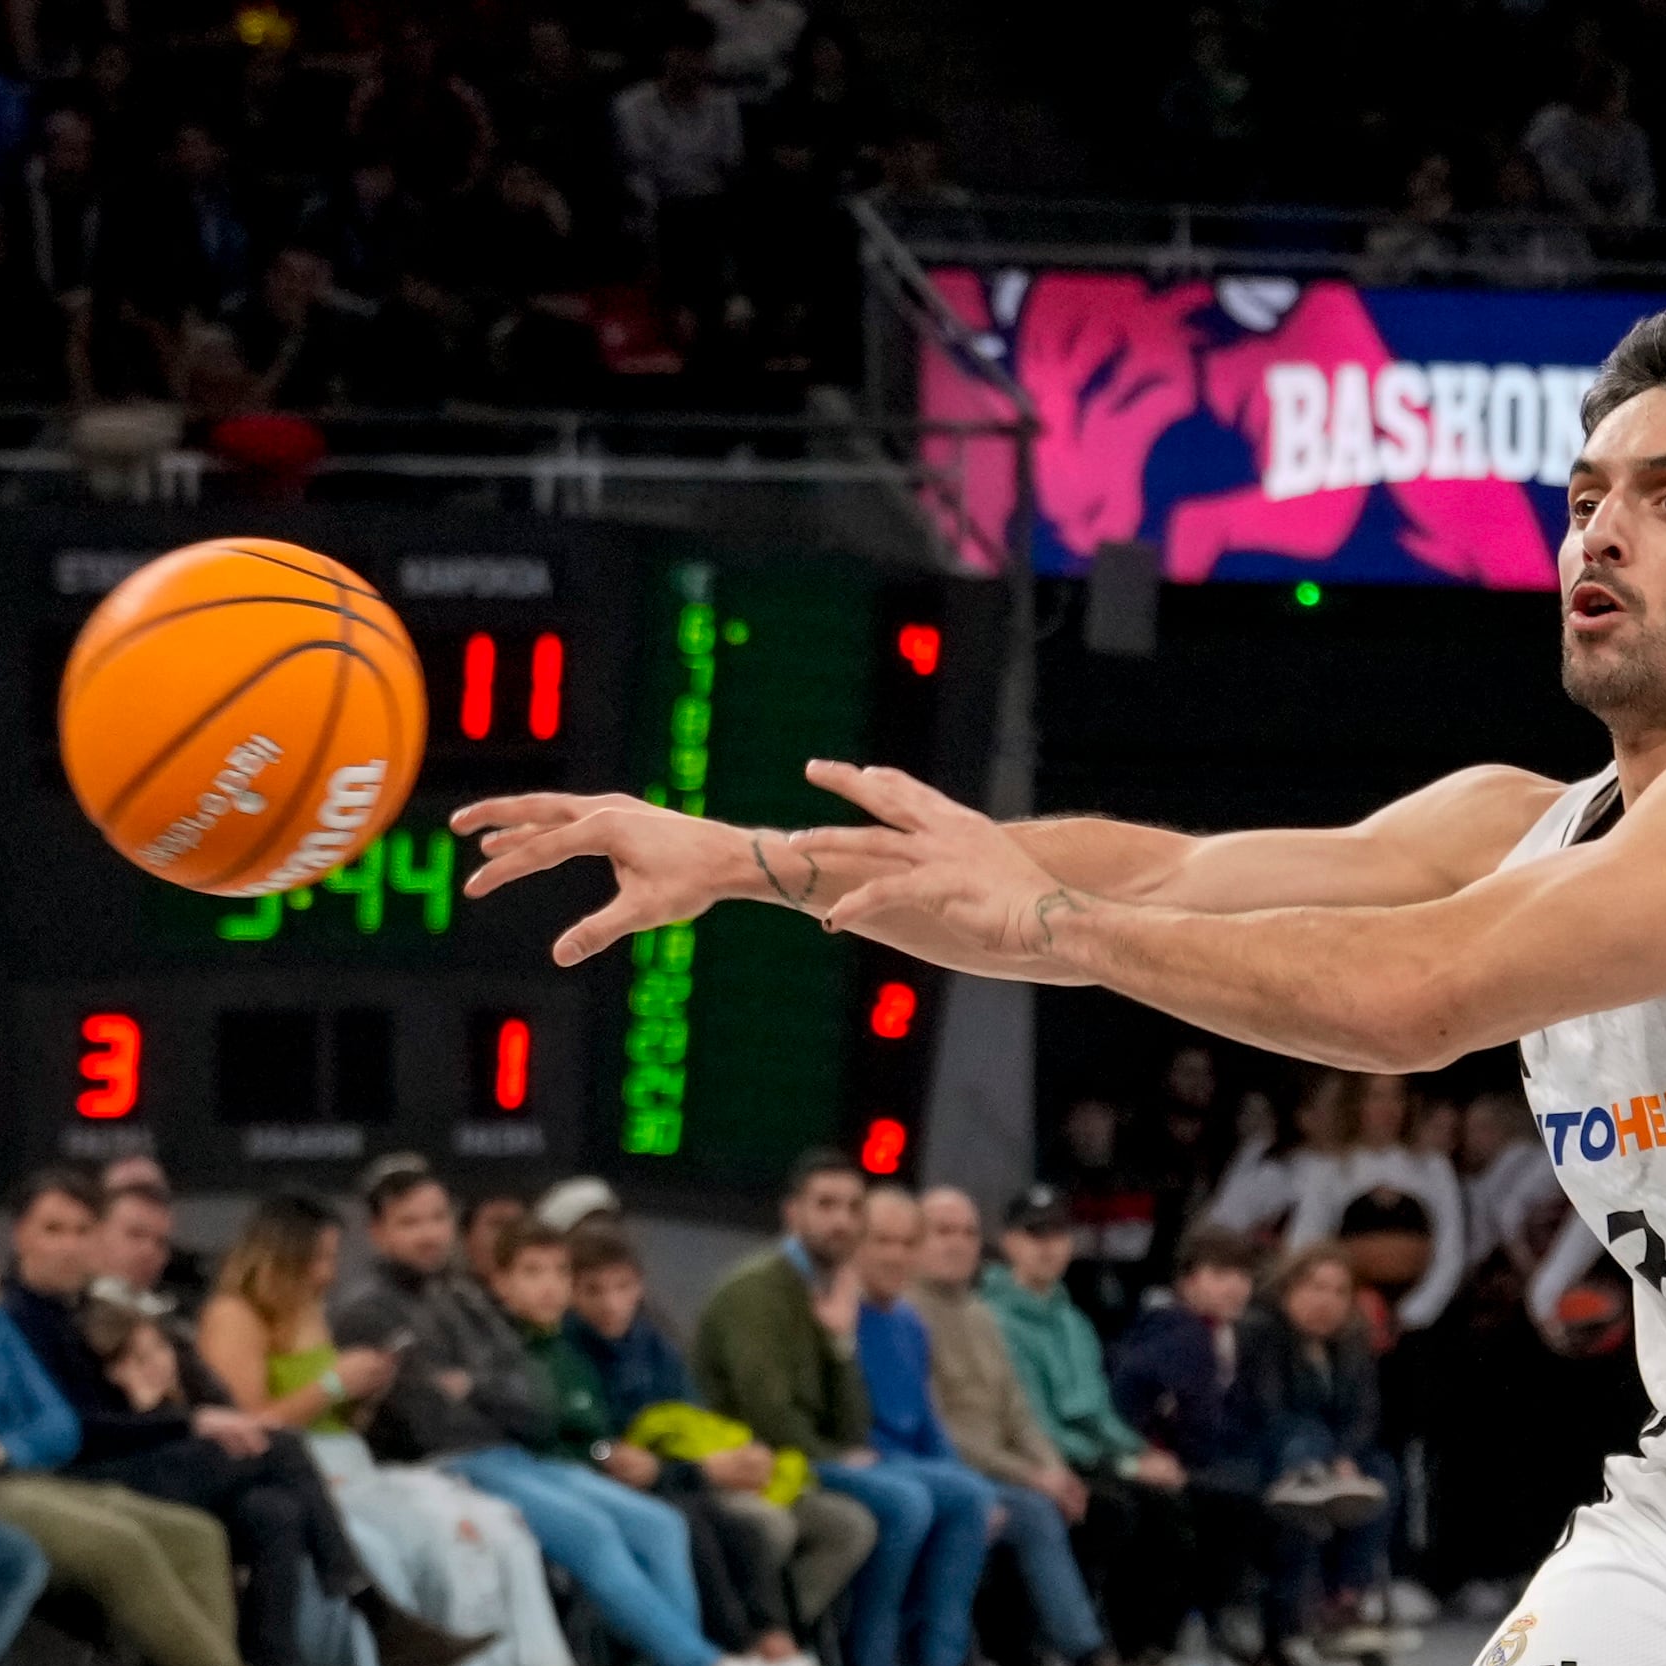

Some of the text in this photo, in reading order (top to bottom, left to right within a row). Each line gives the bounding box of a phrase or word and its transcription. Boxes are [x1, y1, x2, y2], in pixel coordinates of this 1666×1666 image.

[461, 632, 564, 741] 11
[75, 1012, 142, 1119] 3
[495, 1018, 531, 1111] 1
